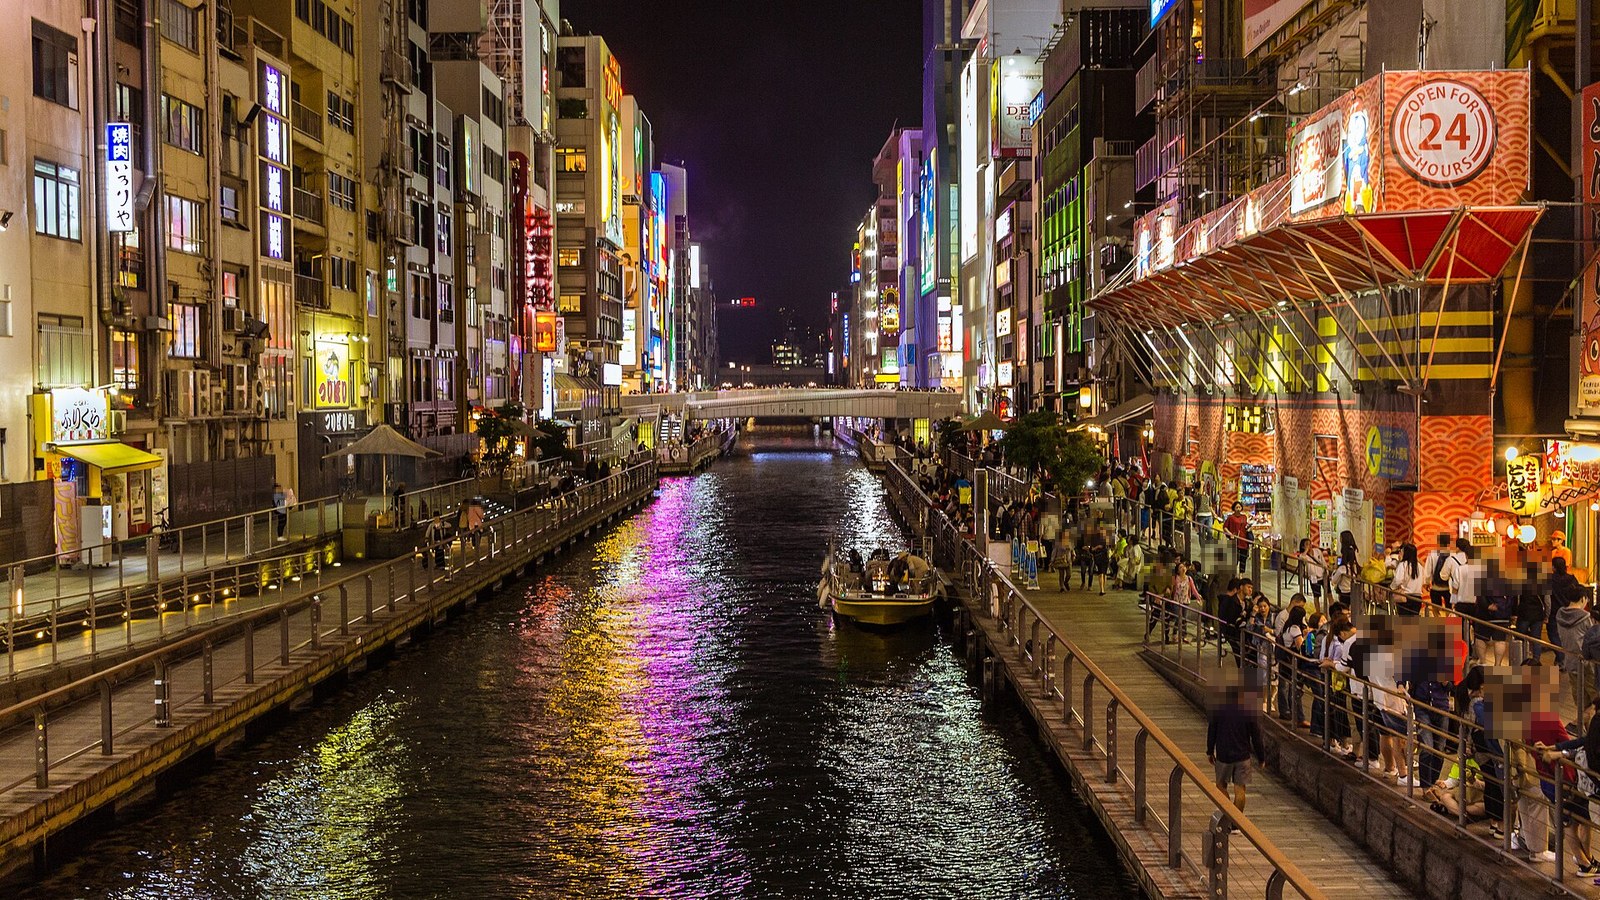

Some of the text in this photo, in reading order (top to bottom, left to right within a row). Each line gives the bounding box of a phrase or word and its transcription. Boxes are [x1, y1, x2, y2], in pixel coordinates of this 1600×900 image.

[1408, 86, 1479, 113] OPEN FOR
[1418, 112, 1471, 151] 24
[112, 126, 130, 227] 焼肉 いろりや
[1415, 156, 1473, 178] HOURS
[1508, 464, 1527, 510] とんぼり
[1525, 461, 1539, 493] たこ焼
